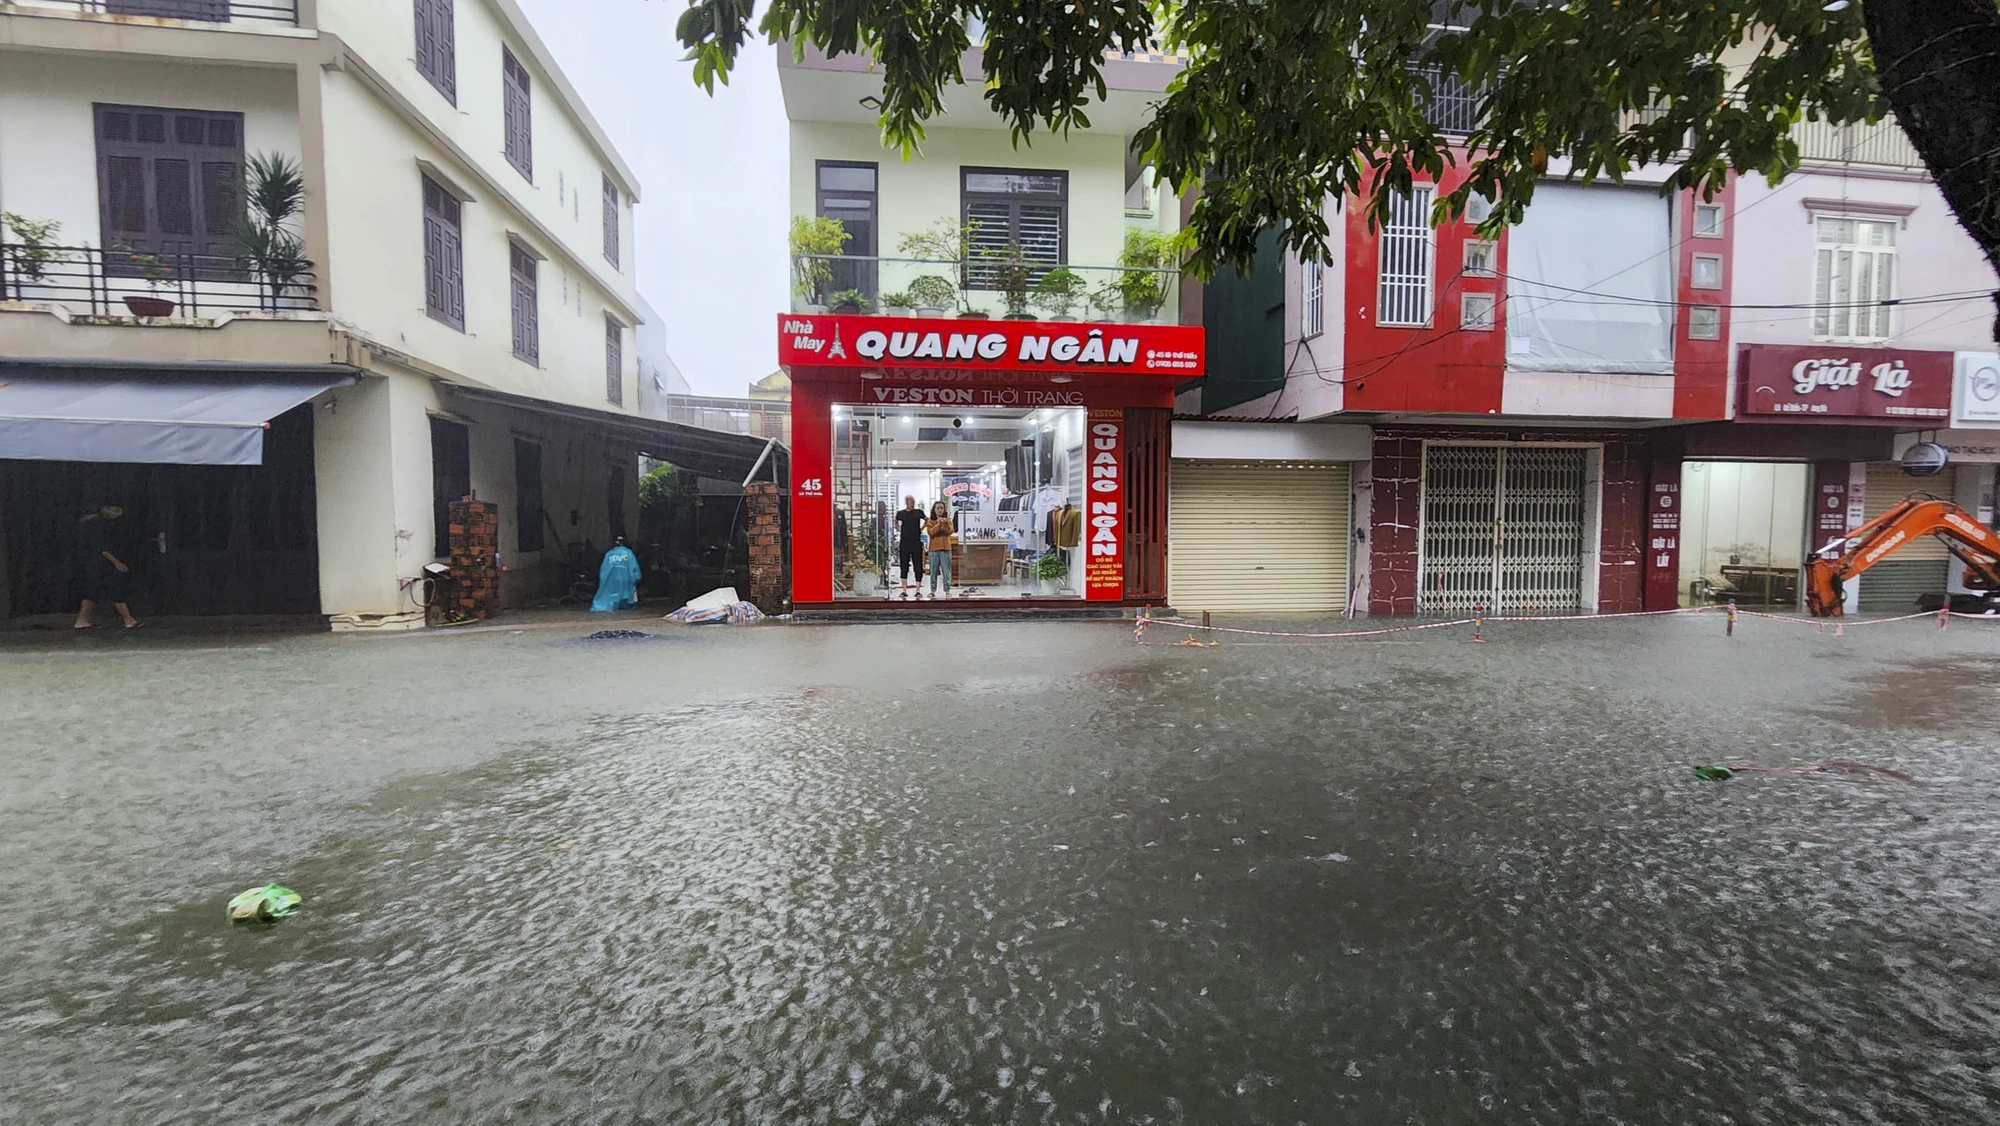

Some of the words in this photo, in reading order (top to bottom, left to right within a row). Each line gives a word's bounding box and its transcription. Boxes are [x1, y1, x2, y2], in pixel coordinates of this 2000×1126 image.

[783, 319, 814, 334] Nhà
[794, 335, 825, 353] May
[855, 330, 1008, 360] QUANG
[1018, 328, 1140, 363] NGÂN
[1792, 357, 1863, 394] Giặt
[1870, 360, 1913, 397] Là
[873, 387, 974, 403] VESTON
[981, 387, 1019, 404] THỜI
[1025, 391, 1084, 405] TRANG
[1089, 409, 1123, 417] VESTON
[1091, 423, 1119, 492] QUANG
[801, 478, 822, 491] 45
[943, 483, 968, 497] QUANG
[1091, 501, 1118, 556] NGÂN
